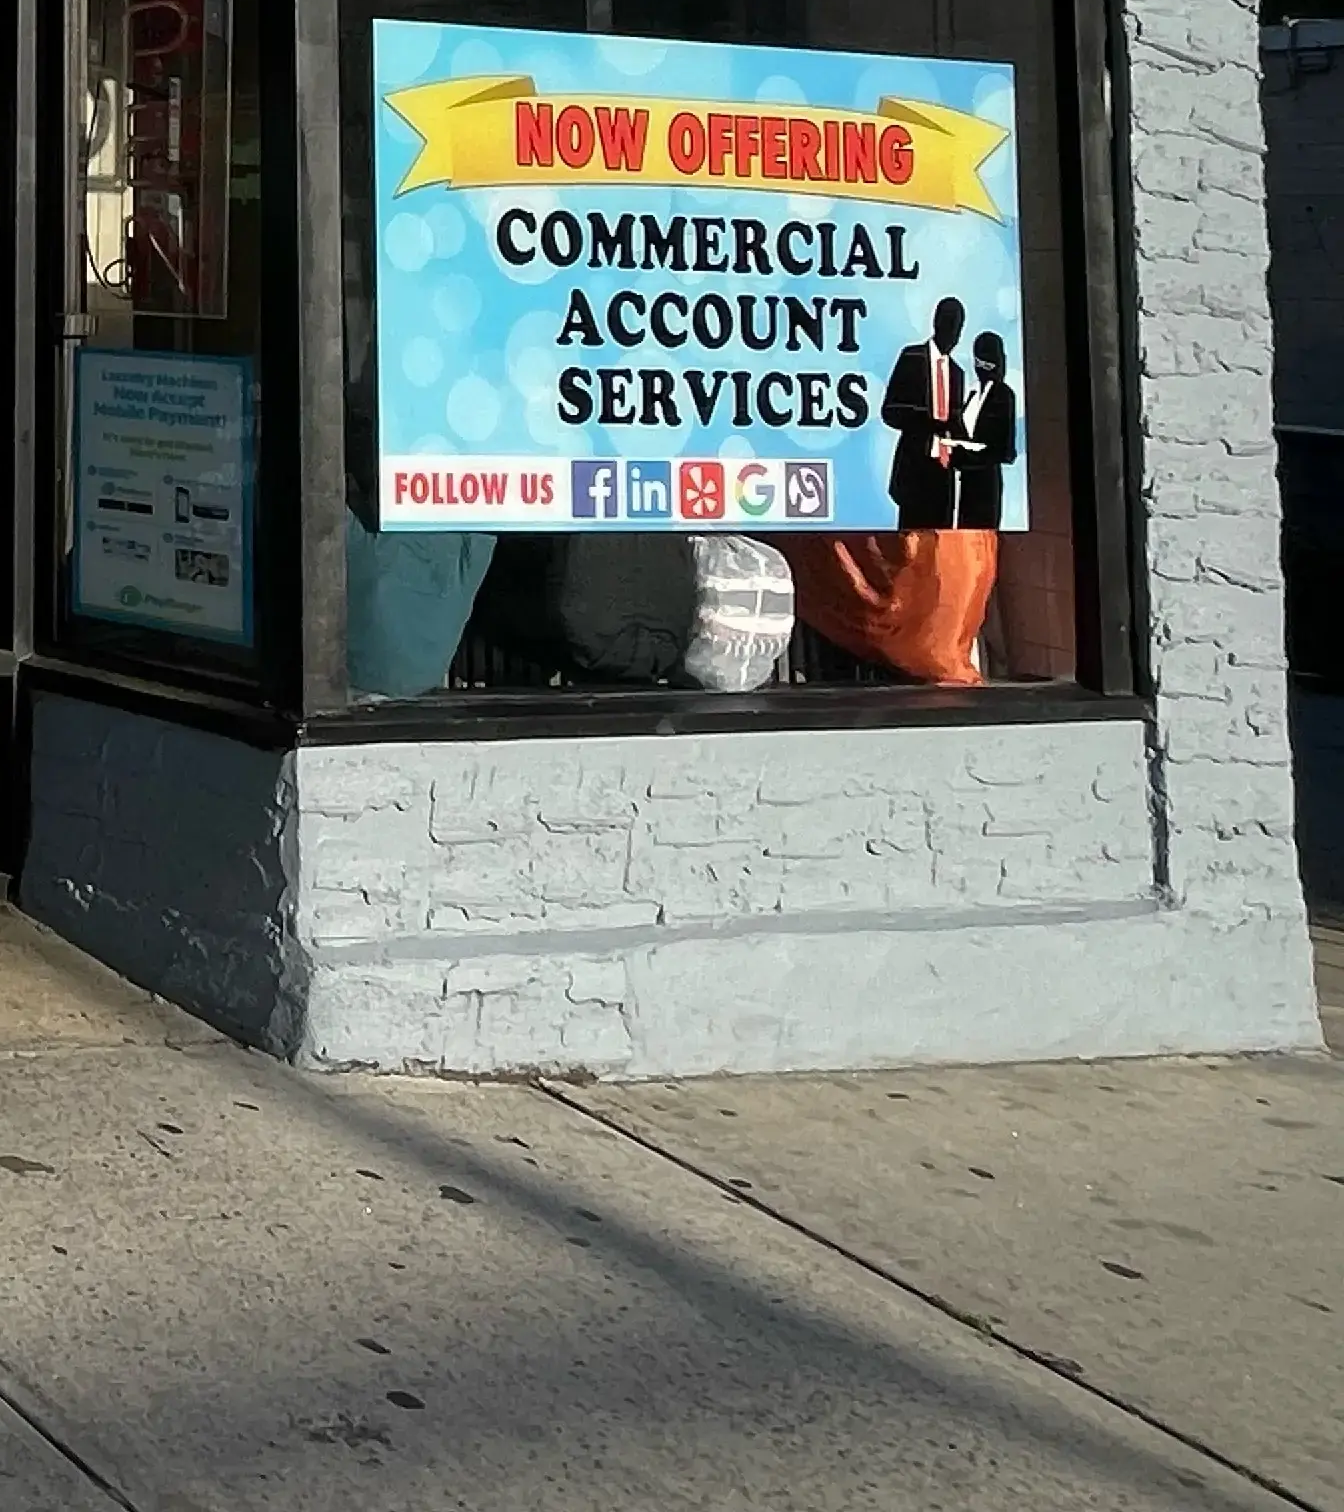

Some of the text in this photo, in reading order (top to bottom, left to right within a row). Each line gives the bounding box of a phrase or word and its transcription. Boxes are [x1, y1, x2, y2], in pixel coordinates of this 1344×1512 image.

[513, 101, 916, 186] NOW OFFERING
[495, 207, 920, 281] COMMERCIAL
[556, 288, 868, 353] ACCOUNT
[557, 366, 870, 429] SERVICES
[394, 472, 509, 504] FOLLOW
[520, 473, 554, 504] US
